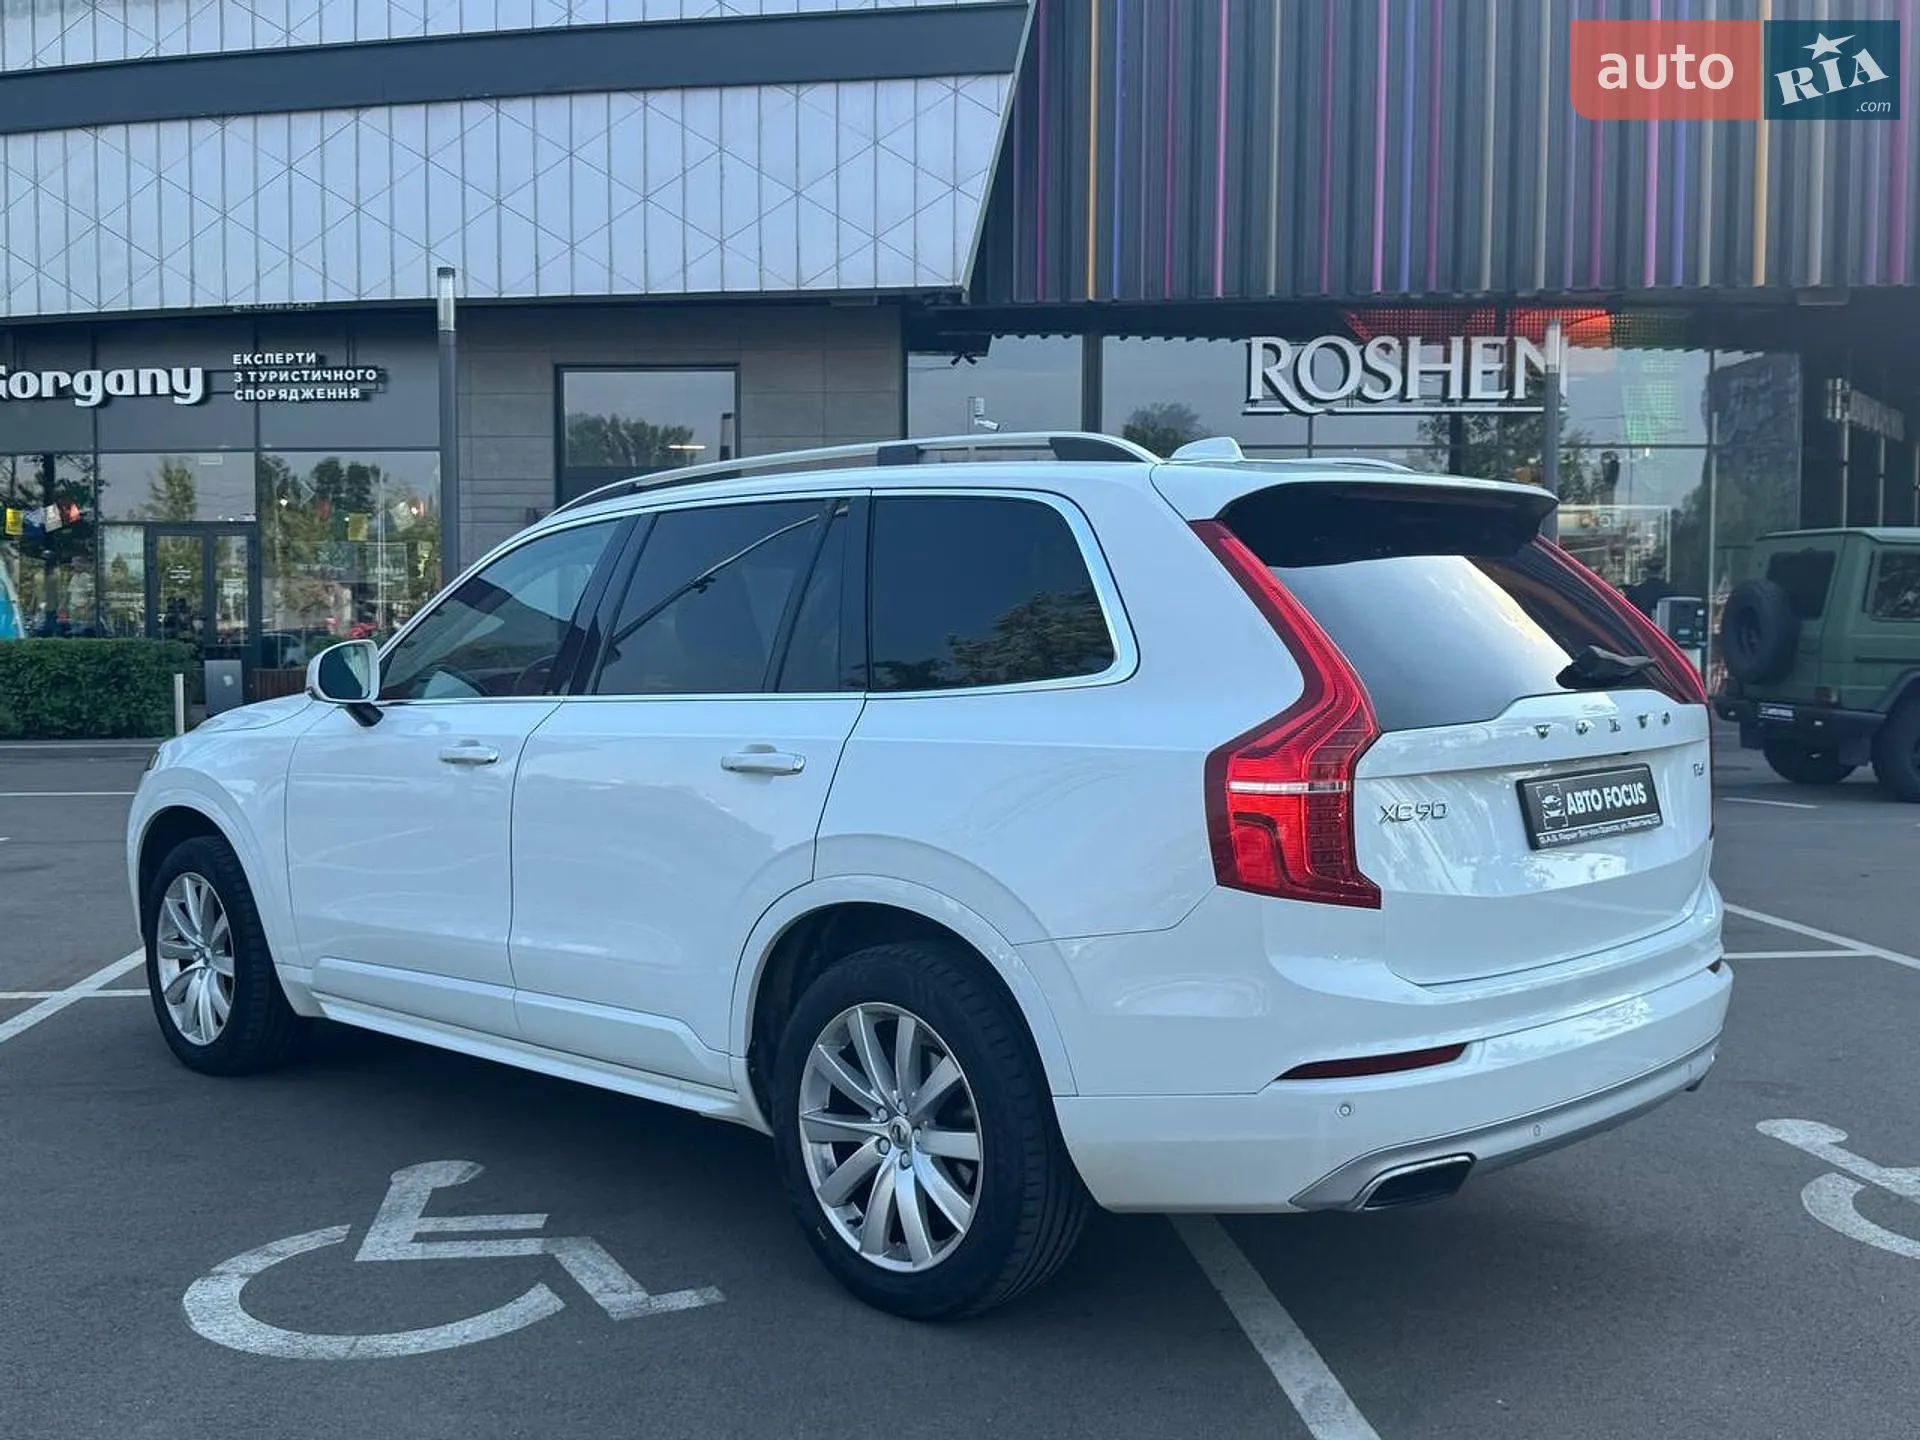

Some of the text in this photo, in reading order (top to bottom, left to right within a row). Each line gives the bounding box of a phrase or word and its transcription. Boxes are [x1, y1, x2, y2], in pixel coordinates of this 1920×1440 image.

[233, 352, 316, 365] ЕКСПЕРТИ
[0, 365, 203, 407] organy
[248, 369, 377, 383] ТУРИСТИЧНОГО
[1249, 335, 1567, 414] ROSHEN
[234, 388, 360, 401] СПОРЯДЖЕННЯ
[1534, 711, 1671, 739] VOLVO
[1603, 782, 1647, 810] FOCUS
[1379, 802, 1448, 824] XC90
